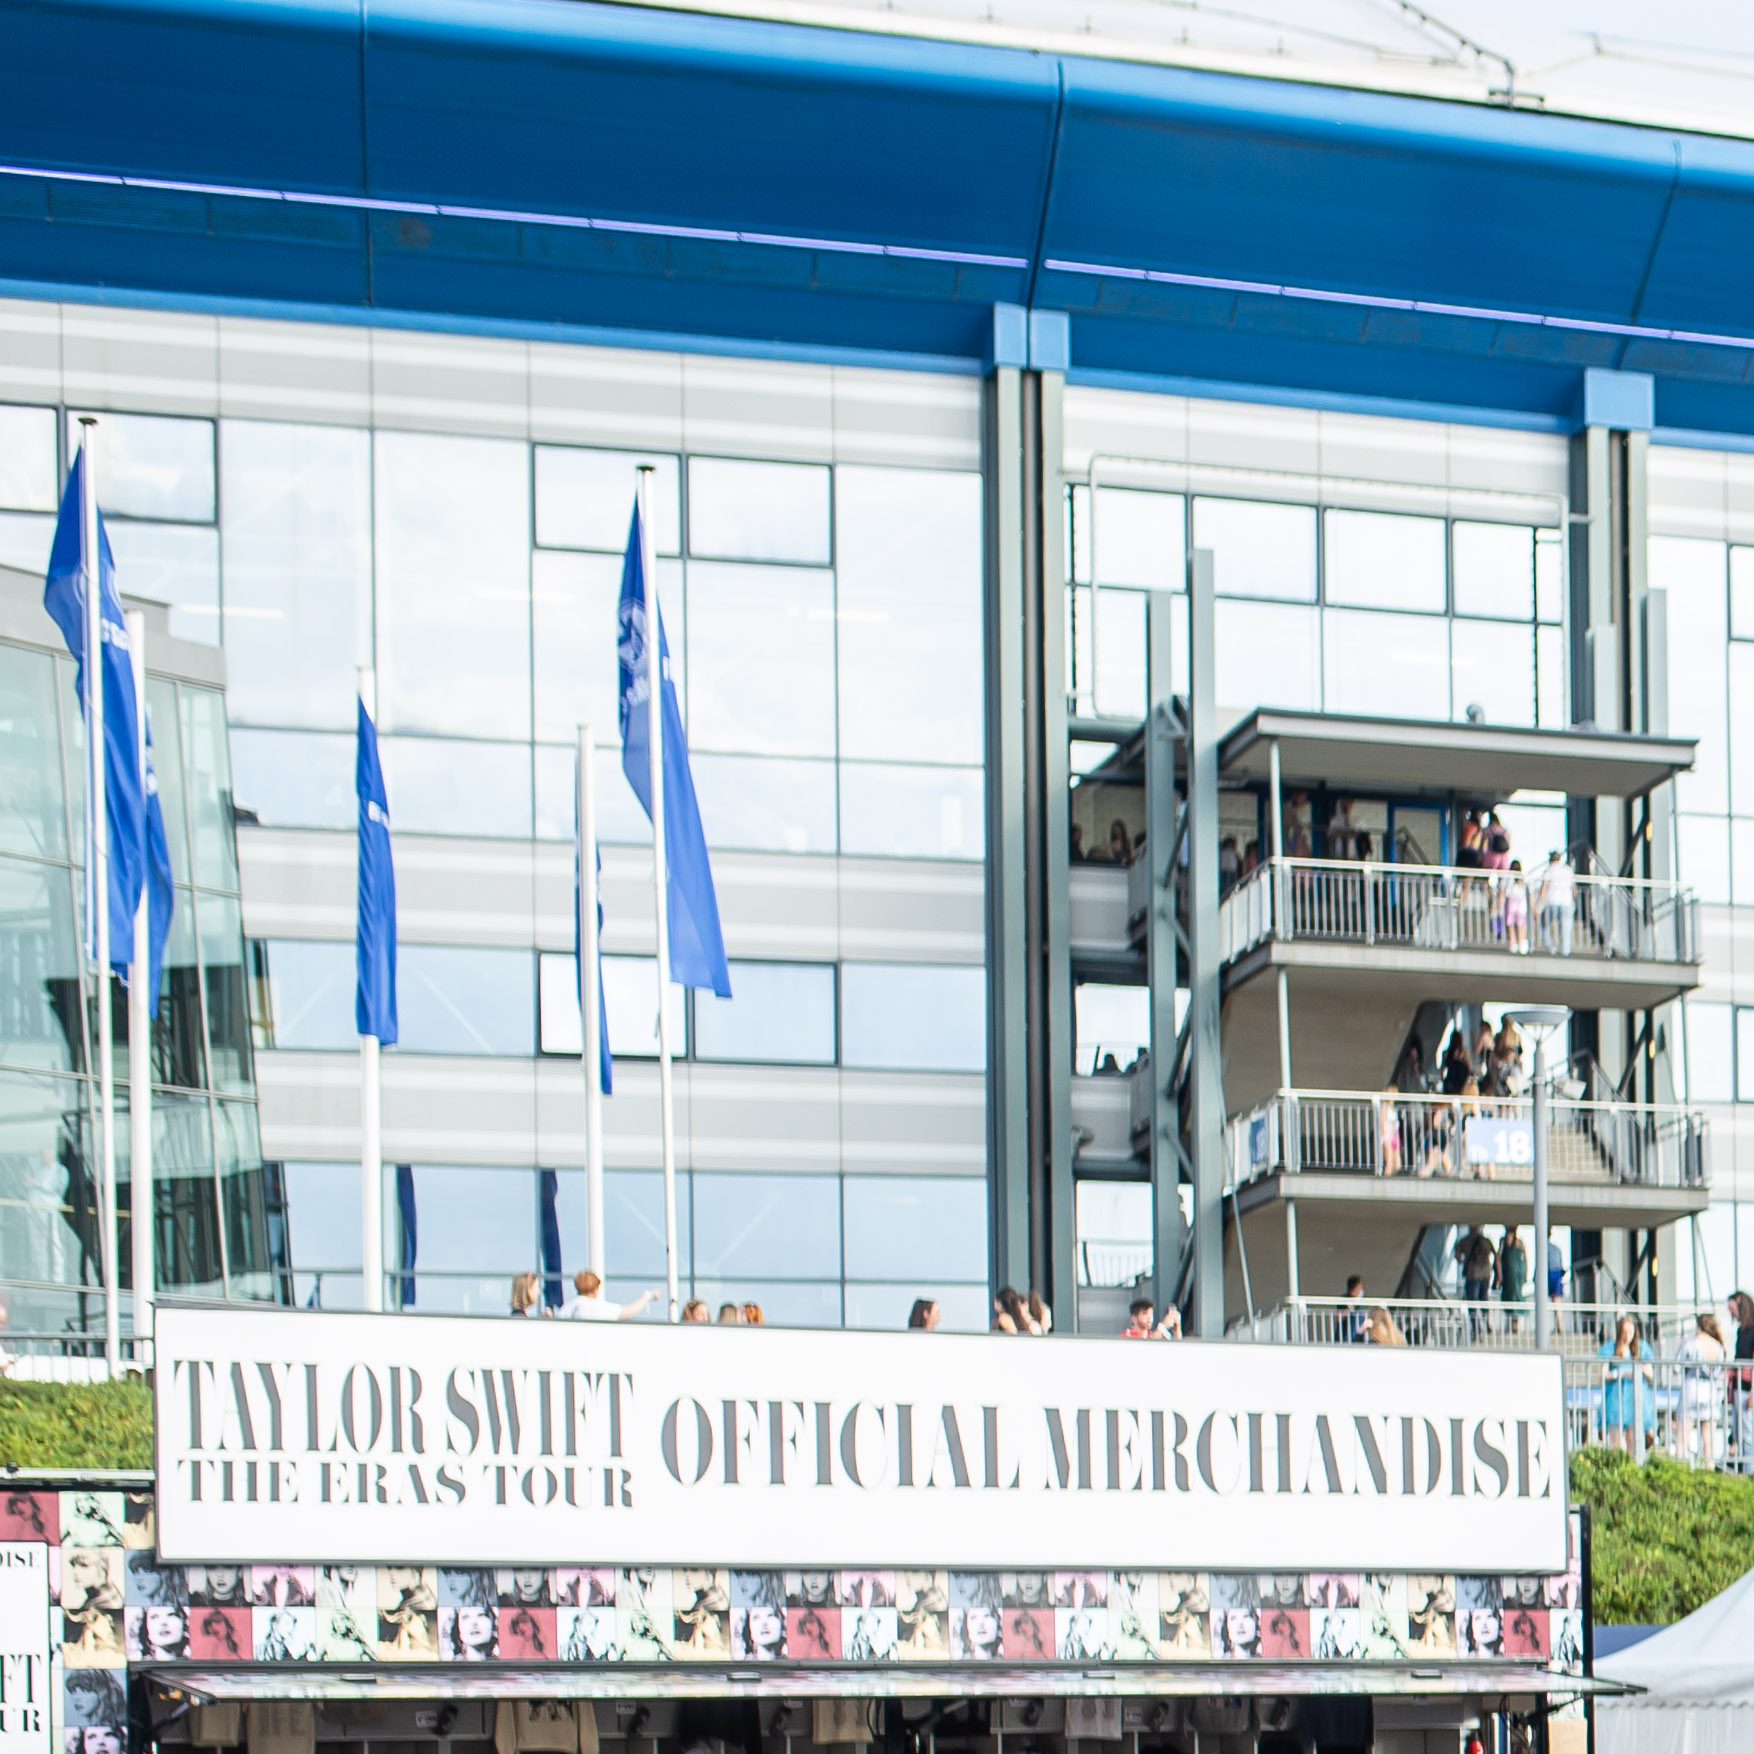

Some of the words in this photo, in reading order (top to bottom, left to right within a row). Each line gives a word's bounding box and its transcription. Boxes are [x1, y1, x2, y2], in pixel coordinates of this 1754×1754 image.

[1493, 1130, 1530, 1163] 18
[173, 1360, 425, 1455] TAYLOR
[446, 1367, 634, 1458] SWIFT
[177, 1460, 300, 1502] THE
[320, 1462, 467, 1505] ERAS
[483, 1465, 633, 1508] TOUR
[661, 1396, 1021, 1490] OFFICIAL
[1043, 1406, 1551, 1499] MERCHANDISE
